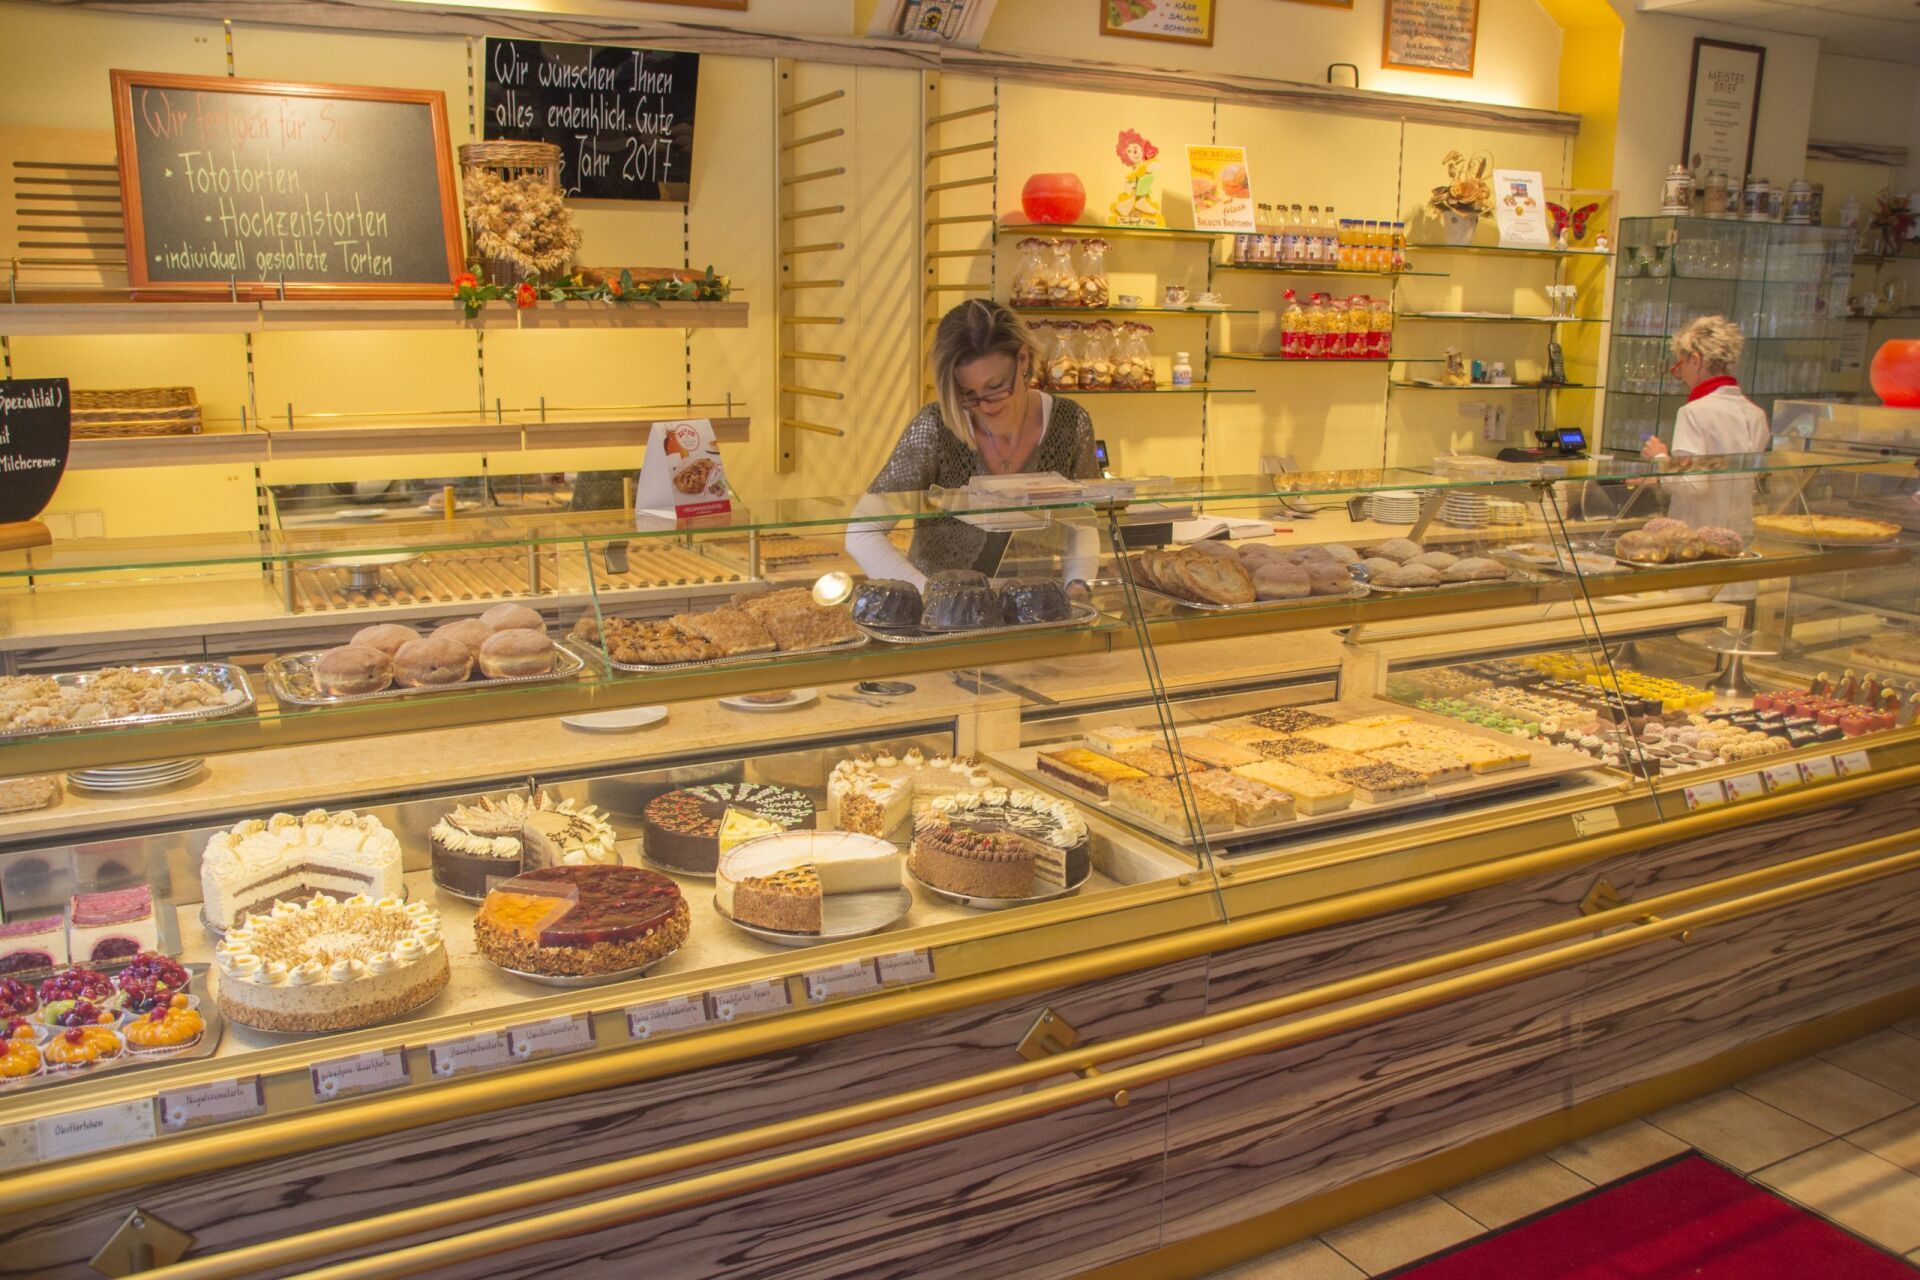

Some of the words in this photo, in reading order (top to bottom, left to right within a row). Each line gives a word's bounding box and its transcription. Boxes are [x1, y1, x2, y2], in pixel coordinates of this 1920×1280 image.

[494, 41, 529, 86] Wir
[538, 48, 615, 91] wünschen
[629, 51, 673, 94] Ihnen
[1708, 71, 1745, 84] MEISTER
[142, 90, 187, 139] Wir
[197, 92, 269, 148] fertigen
[279, 99, 306, 150] für
[320, 103, 352, 142] Sie
[496, 89, 534, 129] alles
[635, 95, 674, 136] Gute
[178, 150, 299, 194] Fototorten
[567, 135, 610, 198] Jahr
[622, 136, 673, 184] 2017
[219, 192, 388, 238] Hochzeitstorten
[1223, 202, 1246, 217] frisch
[164, 240, 246, 271] individuell
[256, 240, 328, 282] gestaltete
[334, 240, 393, 277] Torten
